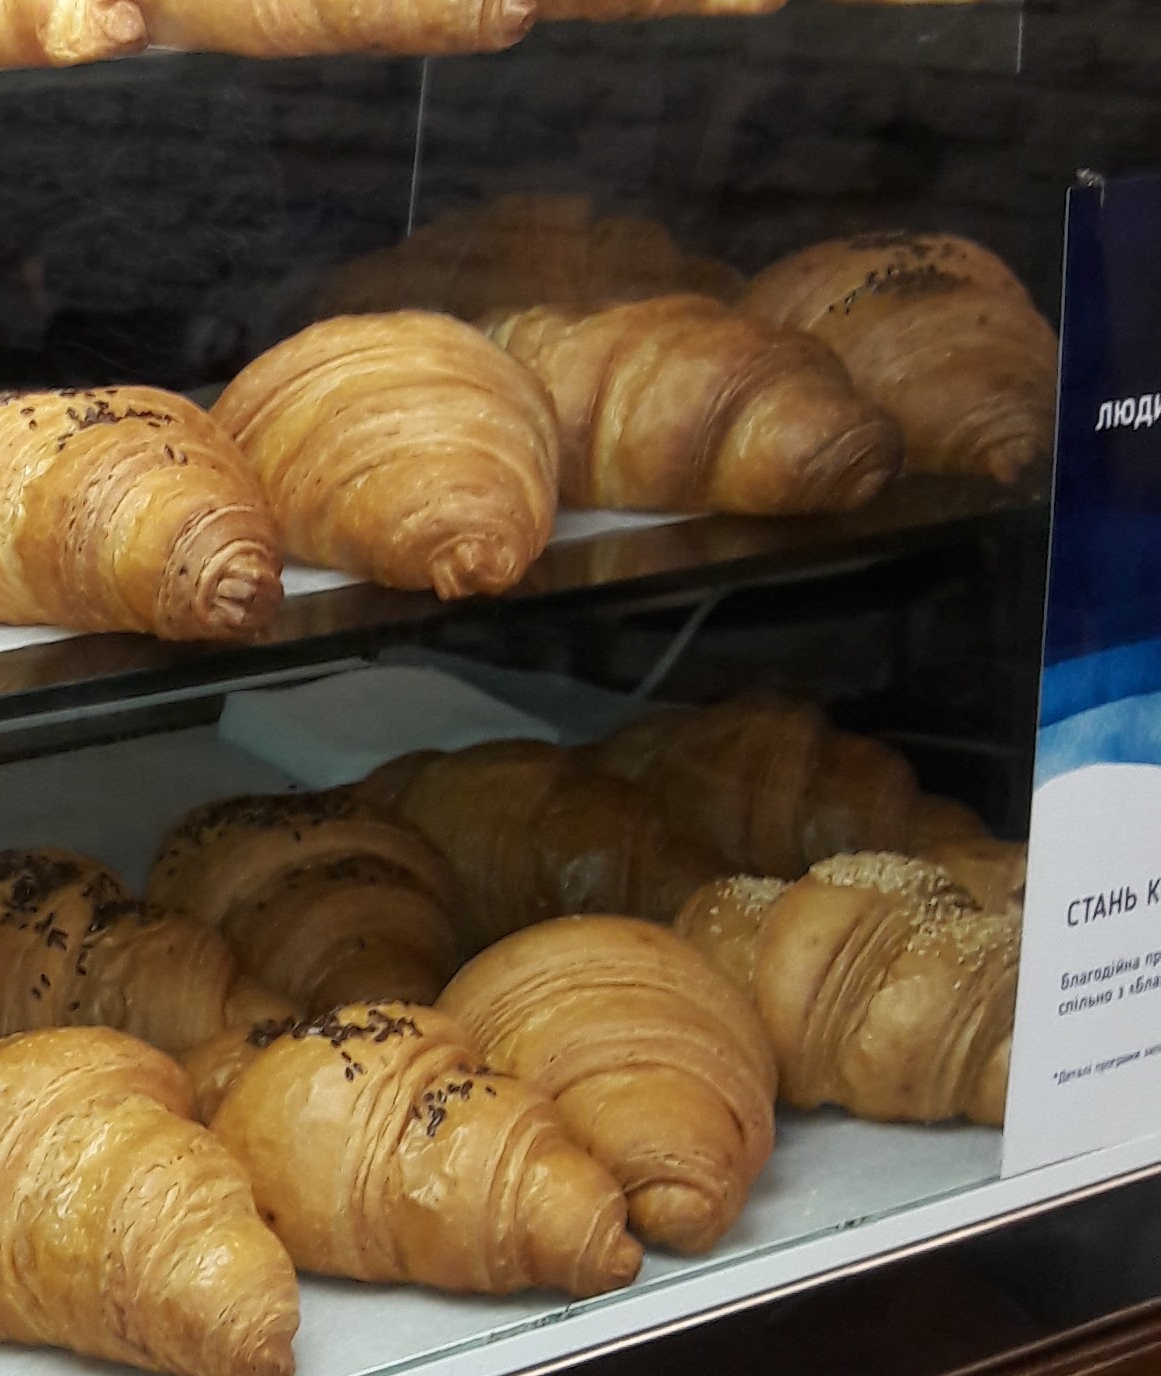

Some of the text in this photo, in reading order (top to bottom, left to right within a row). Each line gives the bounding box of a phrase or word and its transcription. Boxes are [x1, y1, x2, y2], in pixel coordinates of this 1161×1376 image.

[1067, 885, 1137, 927] СТАНЬ
[1061, 956, 1140, 991] Благодійна
[1058, 989, 1113, 1016] спільно
